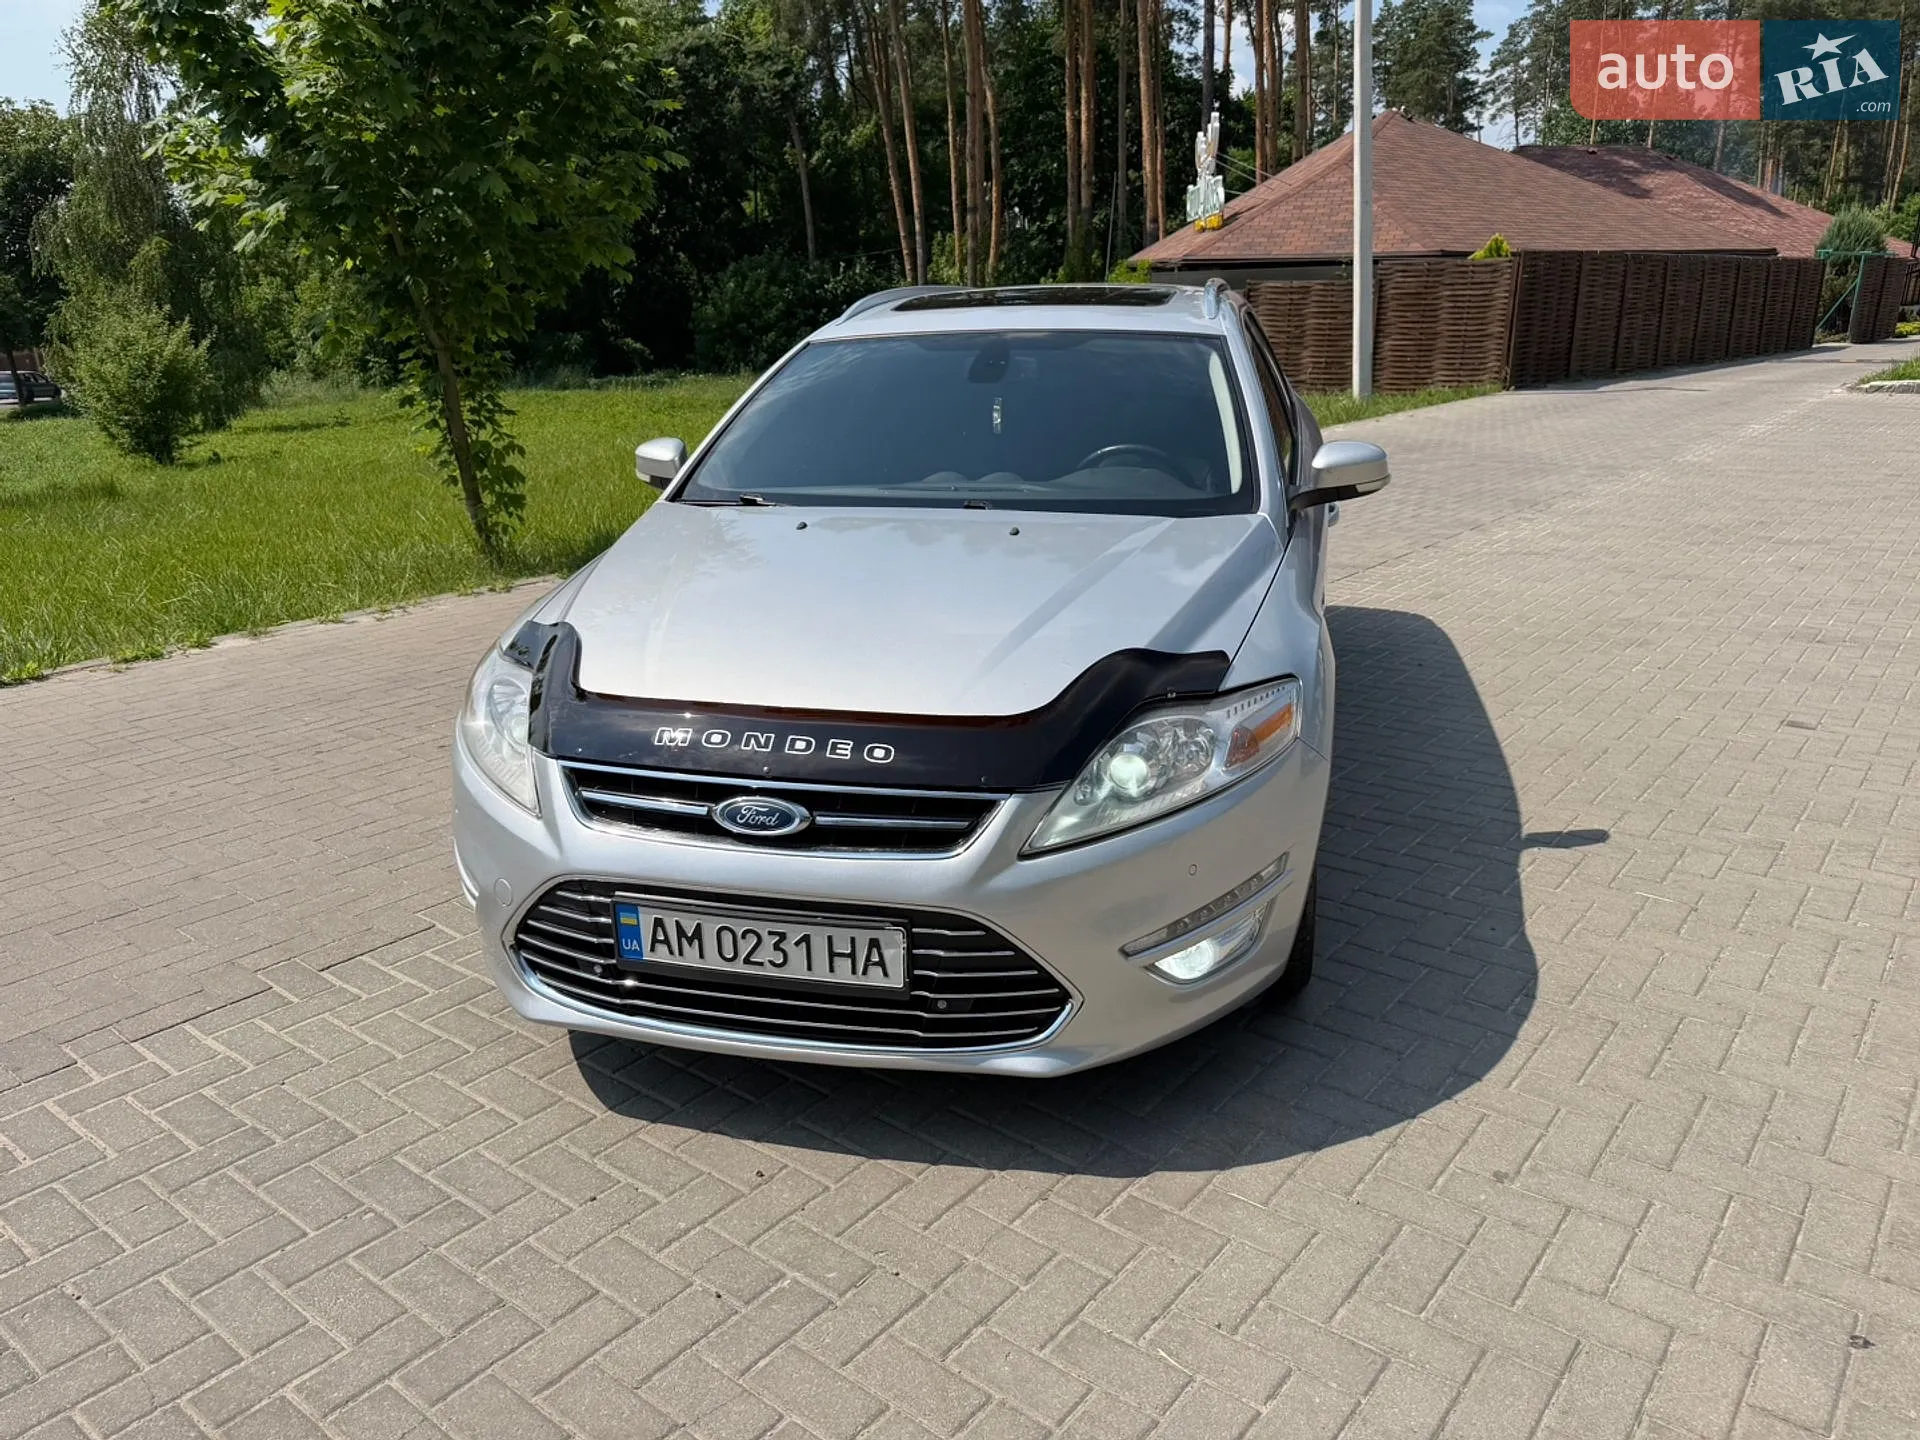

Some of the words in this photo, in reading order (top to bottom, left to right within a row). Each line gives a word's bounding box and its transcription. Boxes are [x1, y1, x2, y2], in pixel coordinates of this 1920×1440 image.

[655, 727, 895, 763] MONDEO
[736, 805, 780, 827] Ford
[622, 938, 641, 952] UA
[649, 915, 705, 960] AM
[715, 924, 813, 972] 0231
[826, 934, 889, 978] HA
